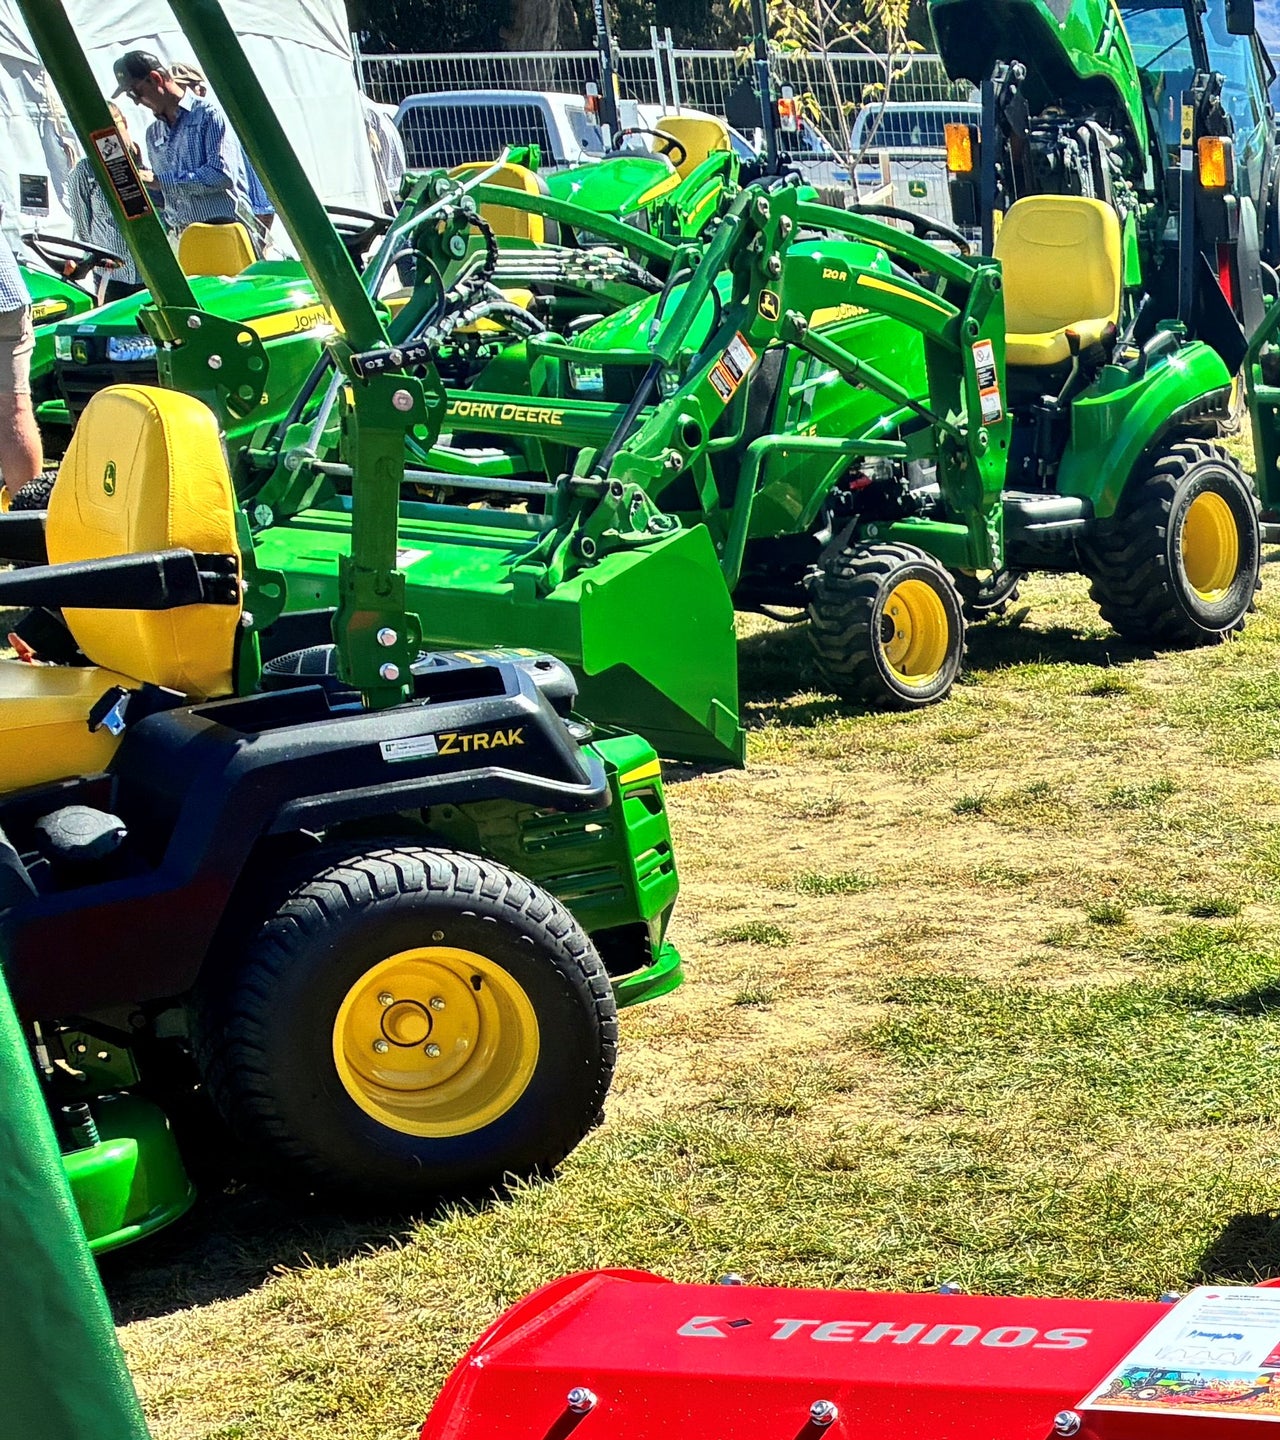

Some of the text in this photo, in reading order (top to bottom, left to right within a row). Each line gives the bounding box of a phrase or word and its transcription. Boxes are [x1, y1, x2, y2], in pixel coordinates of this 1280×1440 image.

[293, 312, 327, 332] JOHN
[446, 400, 565, 426] JOHN DEERE
[437, 727, 526, 756] ZTRAK
[769, 1318, 1094, 1350] TEHNOS
